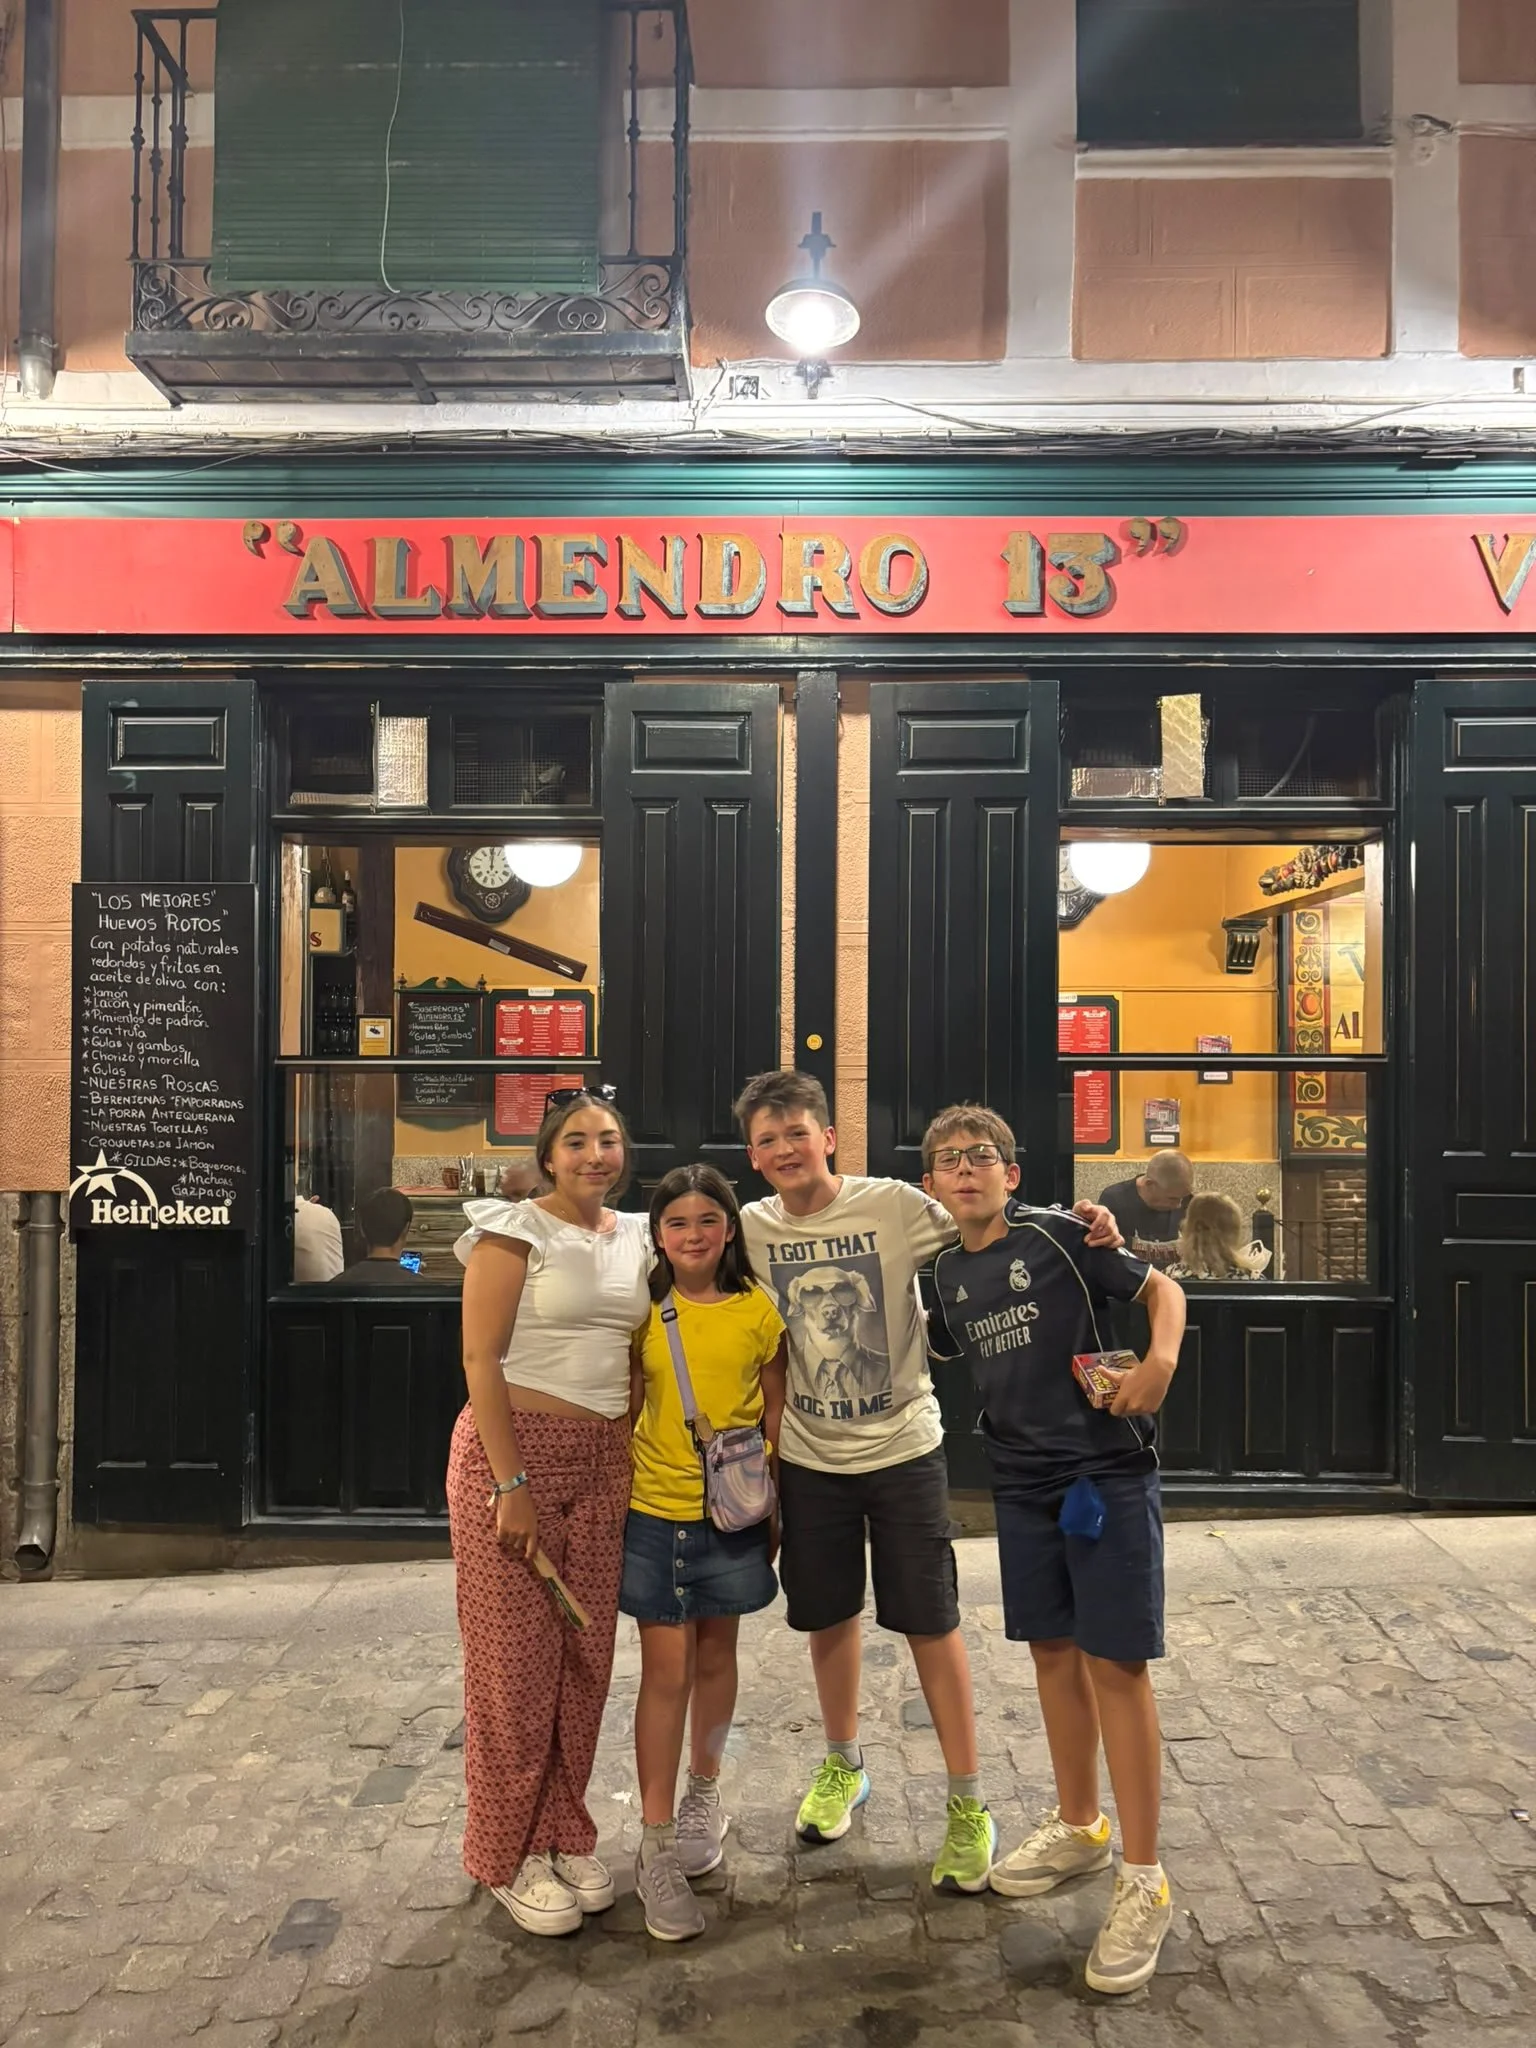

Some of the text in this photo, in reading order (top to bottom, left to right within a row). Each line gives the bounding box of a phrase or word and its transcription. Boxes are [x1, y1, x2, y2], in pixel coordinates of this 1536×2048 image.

[99, 913, 157, 931] HUEVOS
[90, 935, 239, 957] Con patatas naturales
[91, 951, 222, 977] redondas y fritas en
[90, 968, 226, 993] aceite de oliva con:
[93, 986, 128, 999] Jamón
[91, 1009, 145, 1024] Pimientos
[147, 1014, 162, 1025] de
[133, 1001, 141, 1015] y
[115, 1024, 147, 1038] trufa
[91, 1036, 186, 1054] Gulas y gambas
[91, 1050, 200, 1069] Chorizo y morcilla
[92, 1063, 127, 1077] Gulas
[89, 1074, 219, 1093] NUESTRAS ROSCAS
[89, 1091, 166, 1105] BERENJENAS
[91, 1107, 235, 1123] LA PORRA ANTEQUERANA
[90, 1120, 208, 1134] NUESTRAS TORTILLAS
[88, 1136, 154, 1149] CROQUETAS
[171, 1185, 237, 1200] Gazpacho
[90, 1199, 231, 1227] Heineken
[767, 1231, 877, 1262] I GOT THAT
[965, 1301, 1040, 1342] Emirates
[995, 1325, 1032, 1354] BETTER
[829, 1399, 854, 1420] IN
[859, 1390, 893, 1417] ME
